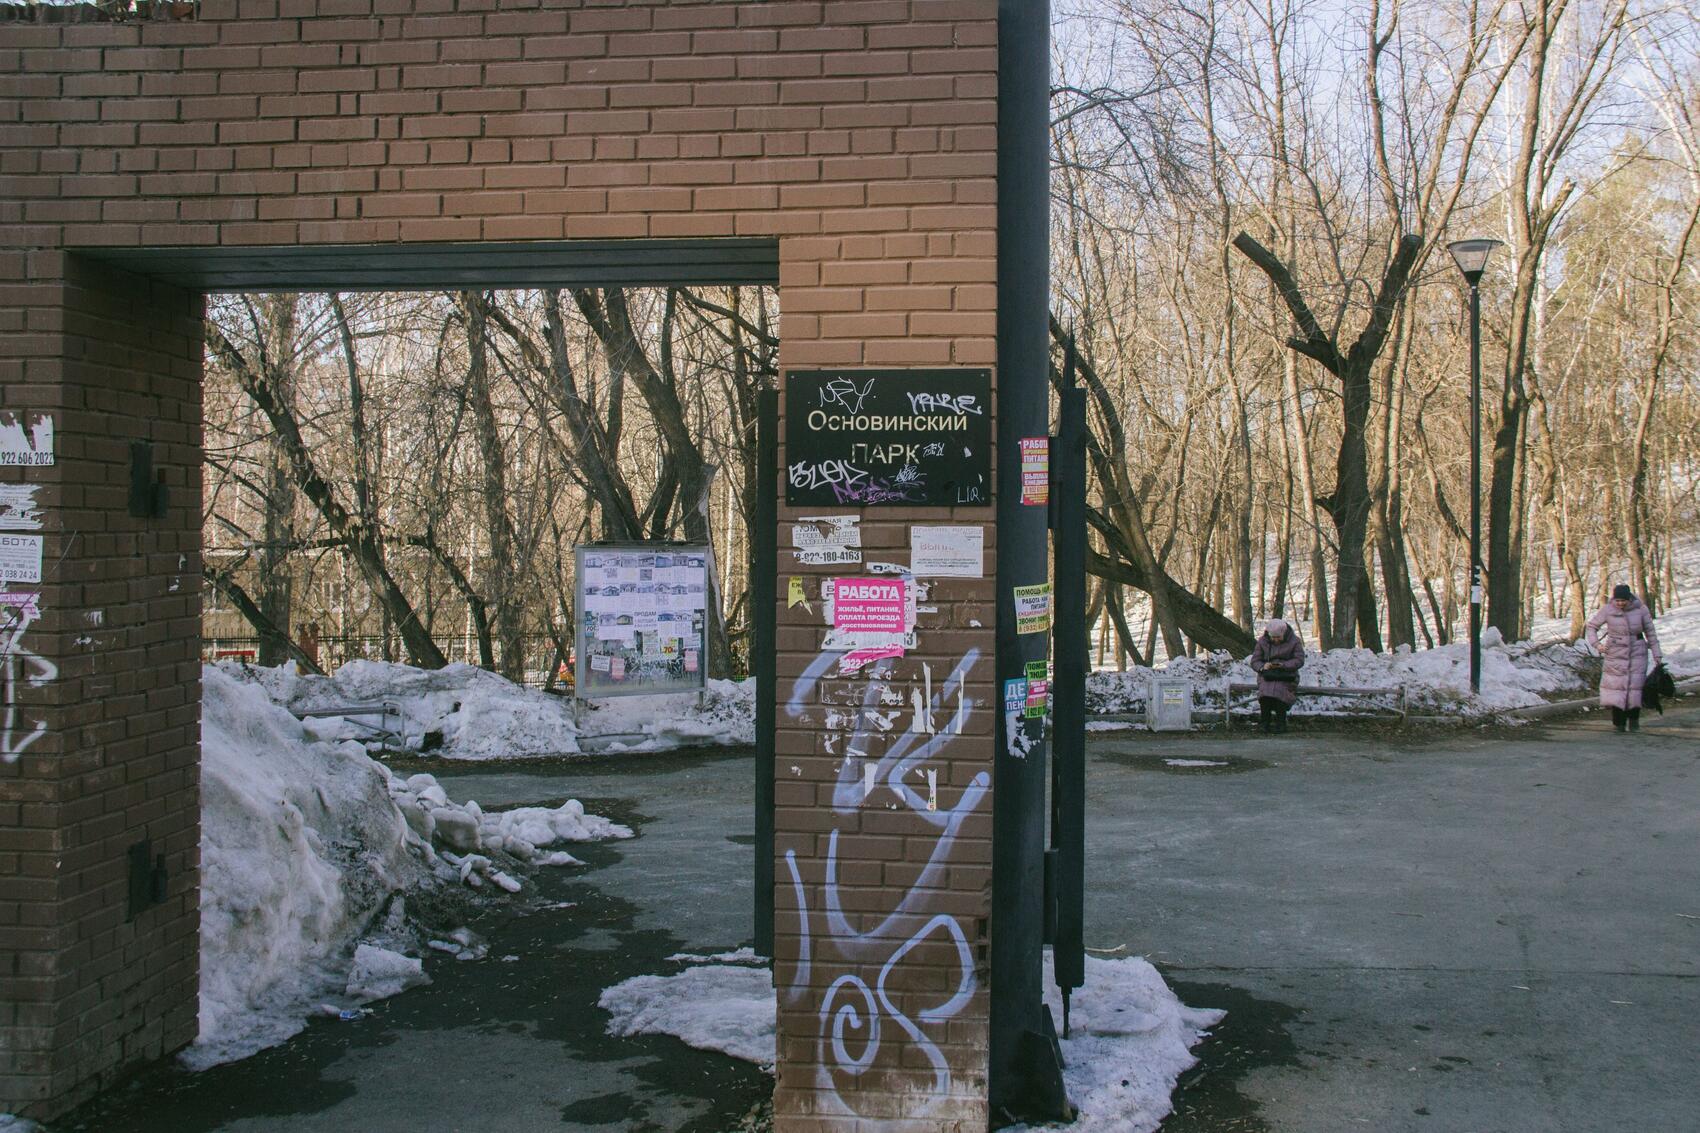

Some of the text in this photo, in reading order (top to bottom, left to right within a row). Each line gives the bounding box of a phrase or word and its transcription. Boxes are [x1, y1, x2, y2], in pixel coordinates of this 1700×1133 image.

[808, 410, 967, 431] Основинский
[2, 452, 15, 464] 922
[18, 452, 32, 464] 606
[852, 443, 920, 464] ПАРК
[0, 537, 37, 547] БОТА
[5, 570, 17, 578] 038
[29, 571, 37, 579] 24
[838, 586, 900, 599] РАБОТА
[867, 614, 901, 622] ПРОЕЗДА
